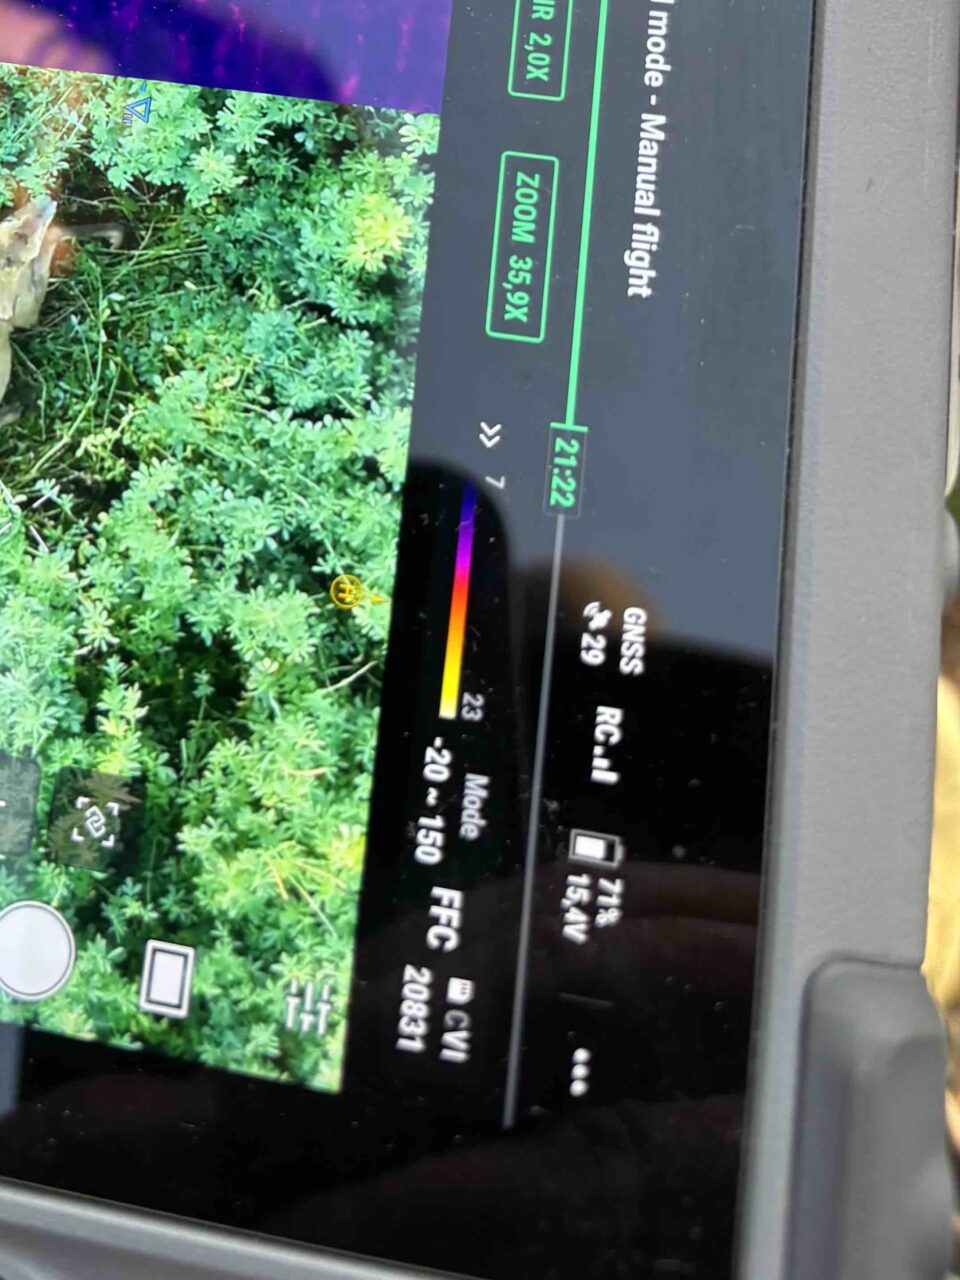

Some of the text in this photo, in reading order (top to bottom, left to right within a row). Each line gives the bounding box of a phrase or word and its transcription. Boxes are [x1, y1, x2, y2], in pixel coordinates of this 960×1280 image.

[525, 32, 553, 81] 2,0X
[643, 10, 671, 87] mode
[633, 113, 666, 215] Manual
[501, 172, 540, 322] ZOOM 35,9X
[623, 221, 658, 298] flight
[485, 476, 505, 489] 7
[549, 436, 579, 508] 21:22
[580, 632, 606, 666] 29
[619, 607, 647, 675] GNSS
[461, 692, 483, 720] 23
[595, 706, 623, 745] RC
[422, 736, 451, 782] -20
[414, 814, 444, 865] 150
[460, 773, 490, 840] Mode
[426, 886, 463, 952] FFC
[561, 874, 590, 944] 15,4V
[594, 877, 623, 928] 71%
[394, 964, 432, 1053] 20831
